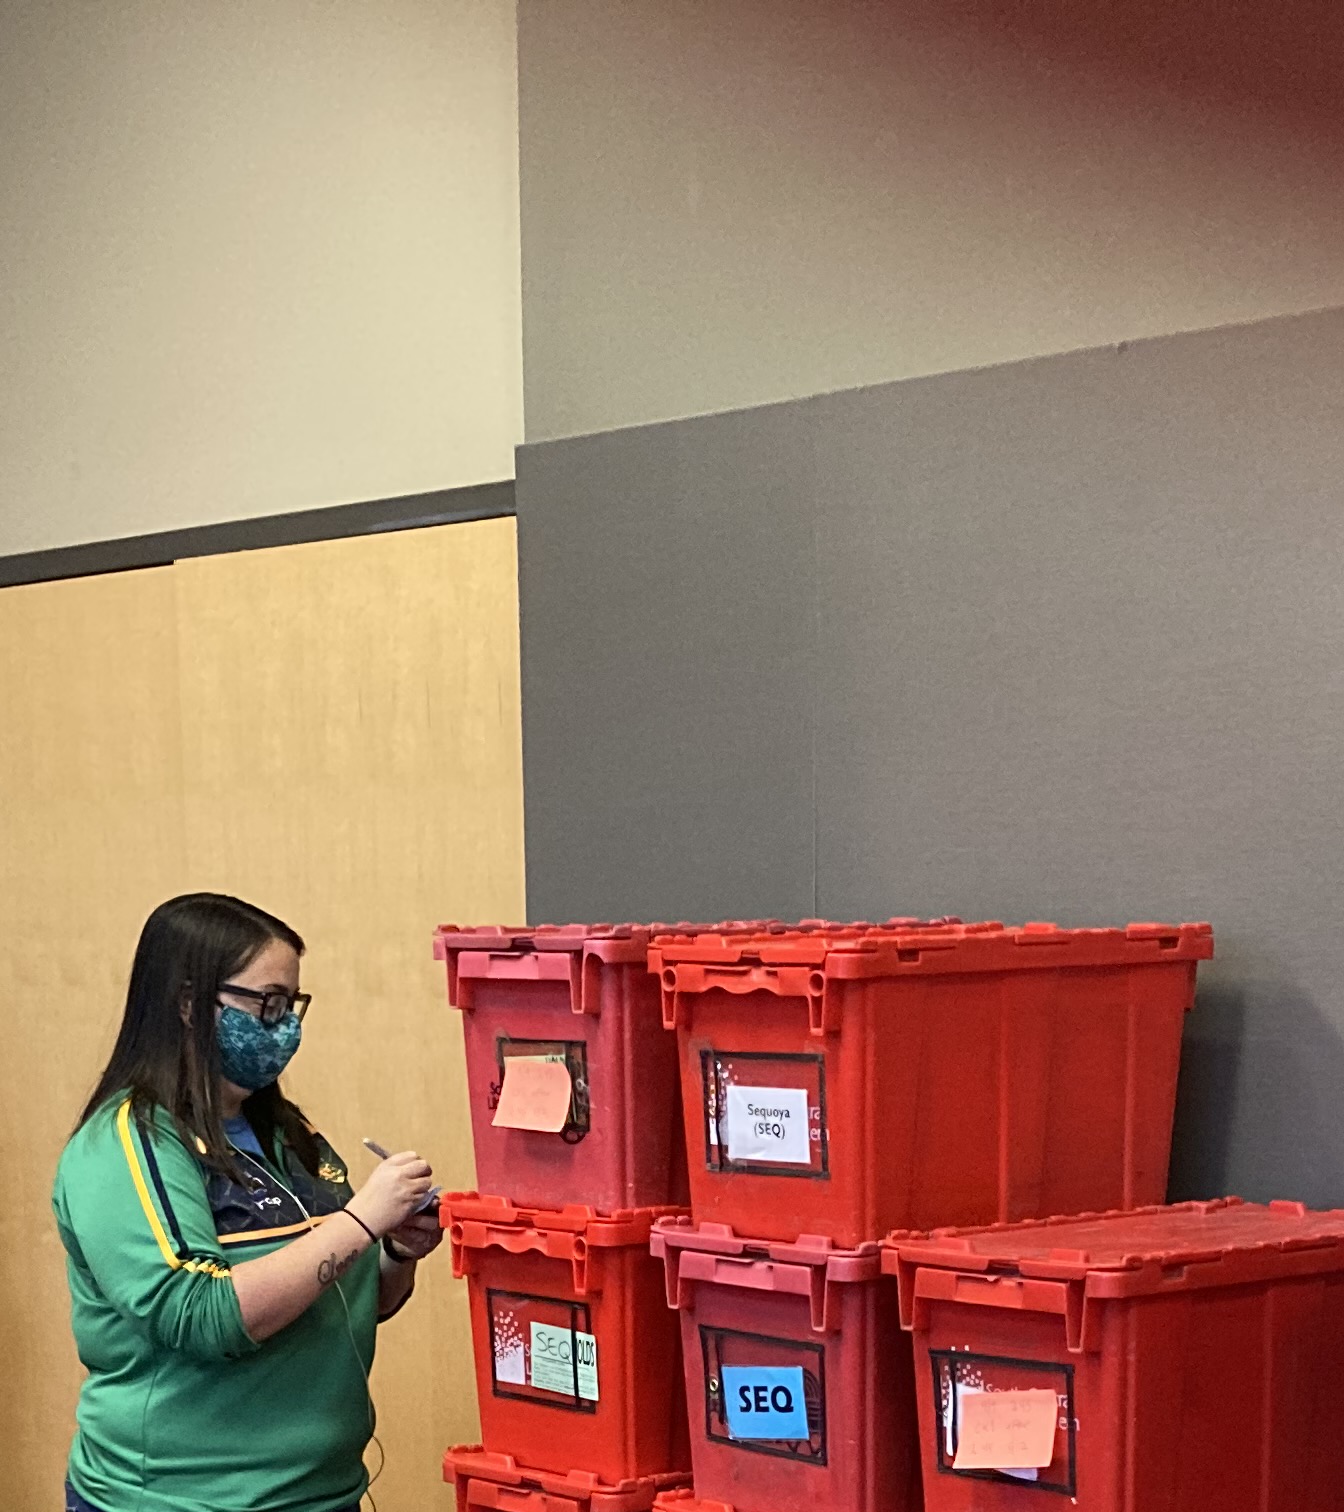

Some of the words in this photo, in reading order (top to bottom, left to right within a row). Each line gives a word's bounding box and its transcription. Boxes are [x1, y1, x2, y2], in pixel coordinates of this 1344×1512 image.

[747, 1103, 791, 1122] Sequoya
[753, 1122, 786, 1140] (SEQ)
[535, 1331, 574, 1366] SEQ
[738, 1385, 794, 1414] SEQ
